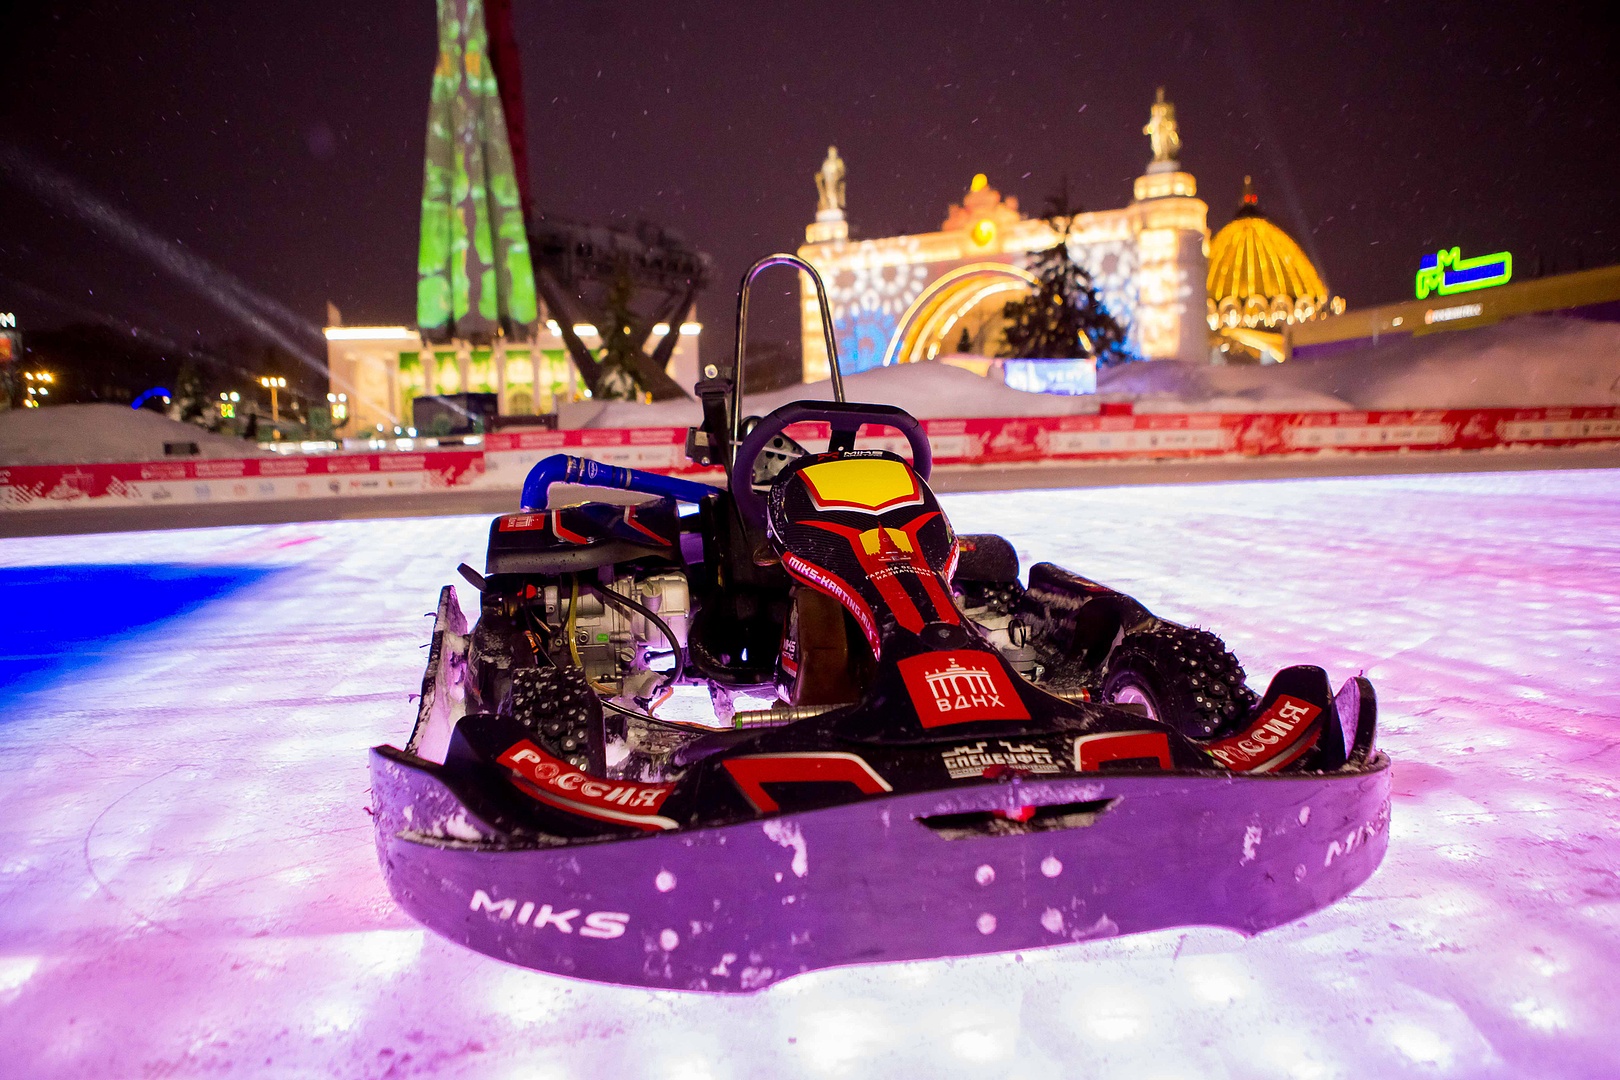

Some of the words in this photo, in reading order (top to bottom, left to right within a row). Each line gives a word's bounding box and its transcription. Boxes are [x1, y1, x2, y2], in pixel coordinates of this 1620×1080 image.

[788, 556, 871, 630] MIKS-KARTING.RU
[936, 694, 1005, 712] ВДНХ
[1212, 700, 1309, 764] РОССИЯ
[509, 749, 666, 807] РОССИЯ
[943, 753, 1053, 770] СПЕЦБУФЕТ
[469, 889, 630, 939] MIKS
